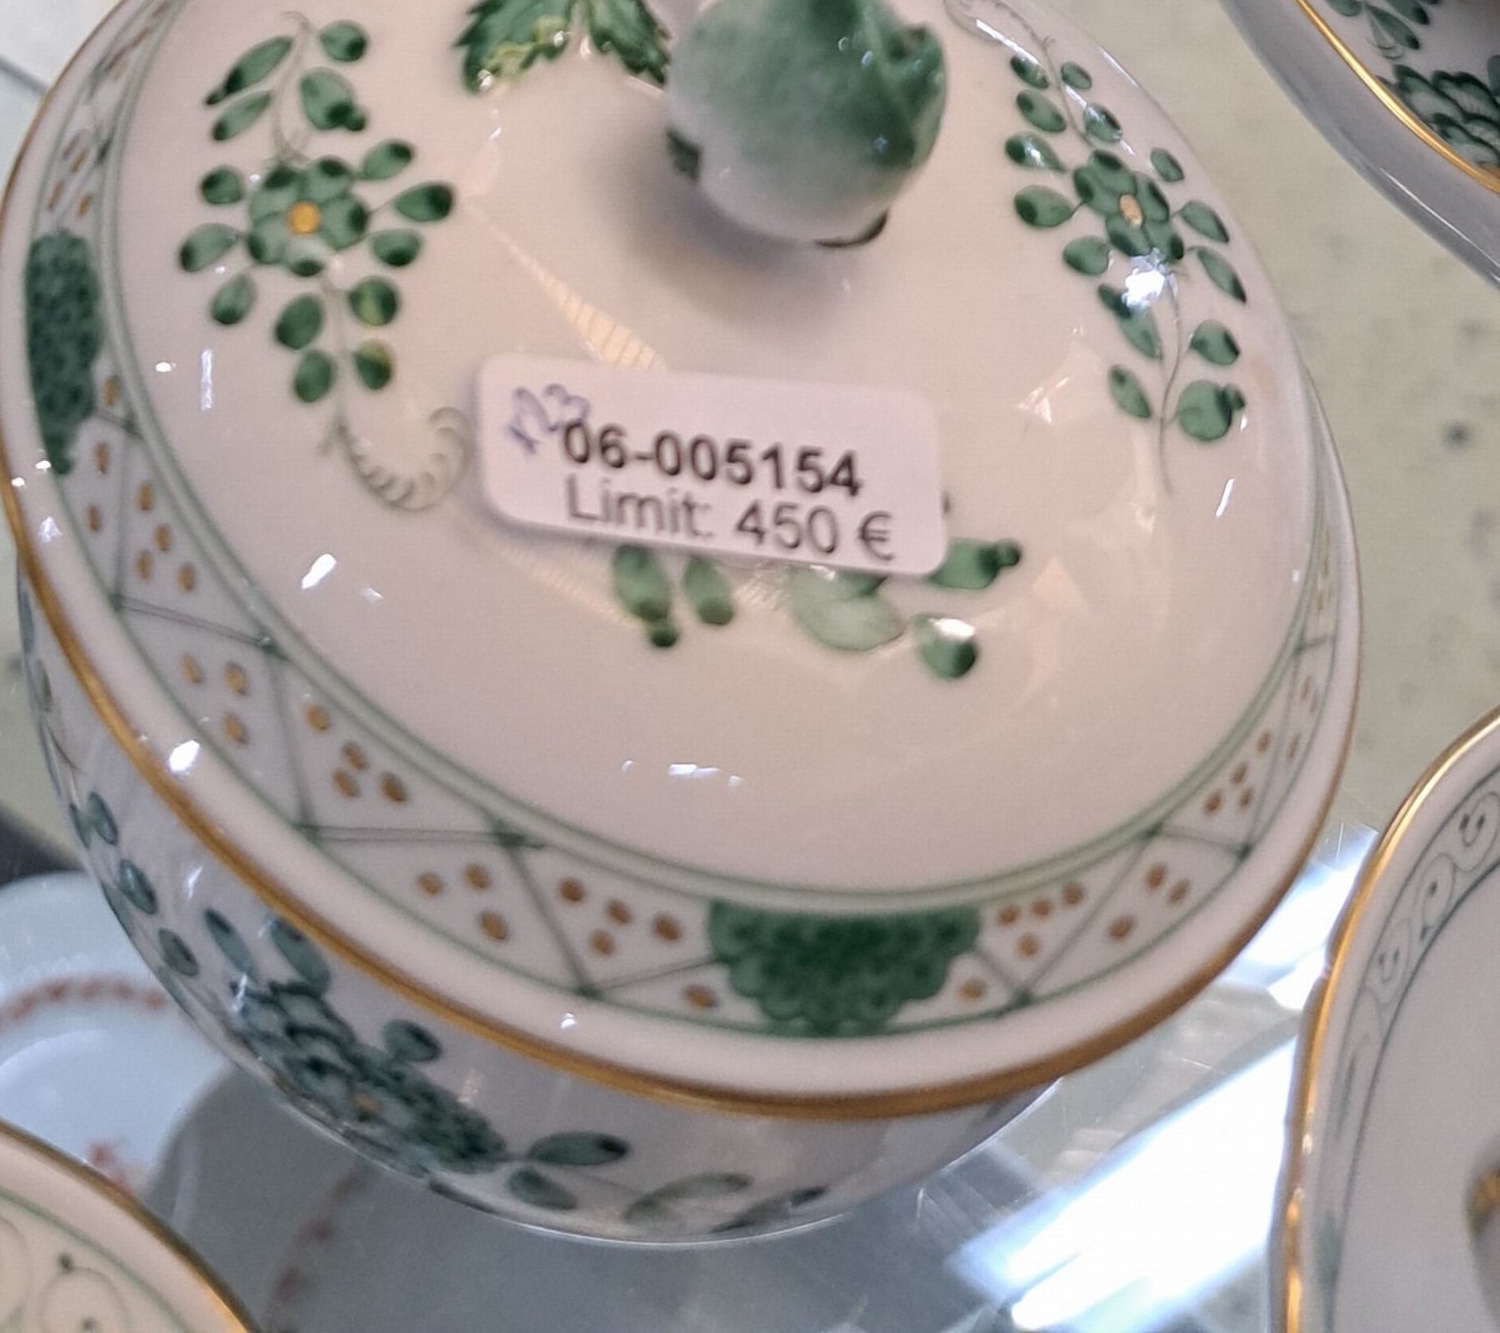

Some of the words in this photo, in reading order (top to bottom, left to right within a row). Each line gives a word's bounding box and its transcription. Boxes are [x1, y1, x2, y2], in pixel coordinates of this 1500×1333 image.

[562, 422, 862, 497] 06-005154
[566, 473, 714, 539] Limit:
[734, 499, 840, 555] 450
[857, 510, 896, 562] €
